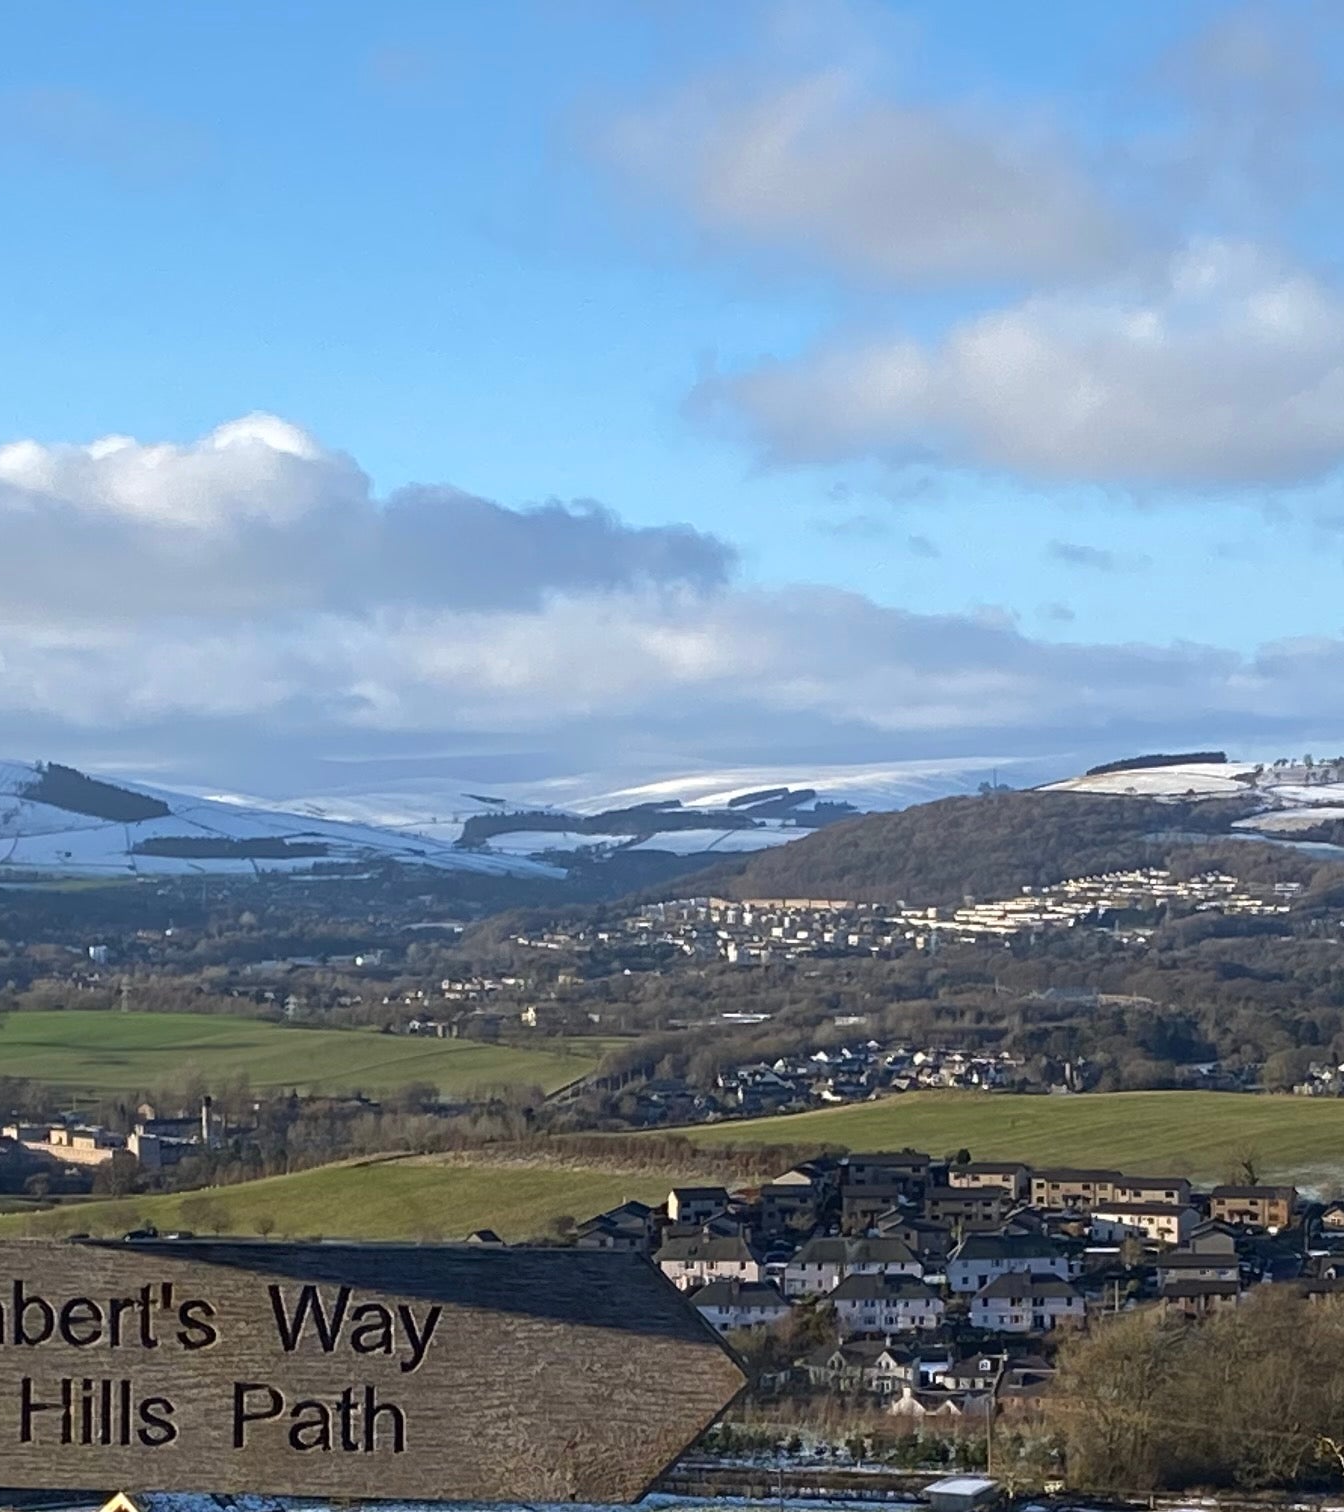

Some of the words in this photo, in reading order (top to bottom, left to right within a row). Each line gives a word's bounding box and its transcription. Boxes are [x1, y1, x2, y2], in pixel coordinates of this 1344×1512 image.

[268, 1284, 444, 1373] Way
[21, 1377, 179, 1447] Hills
[232, 1381, 408, 1454] Path
